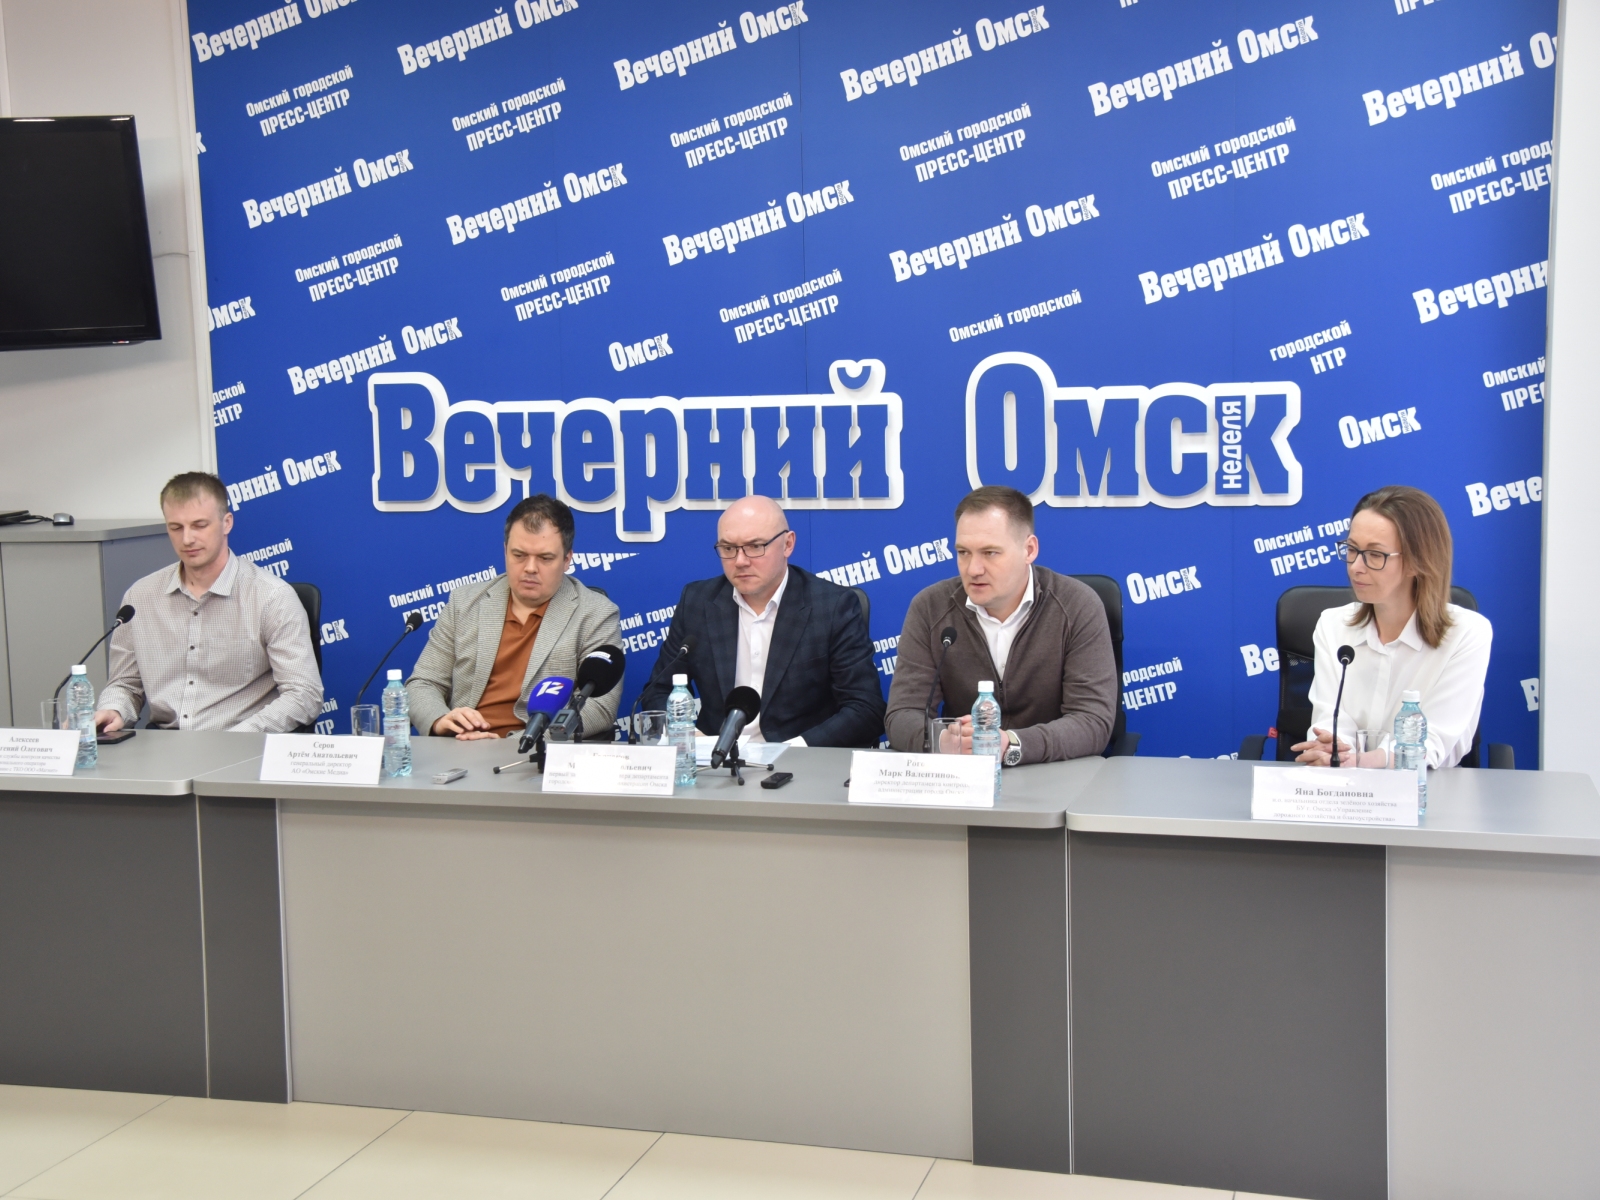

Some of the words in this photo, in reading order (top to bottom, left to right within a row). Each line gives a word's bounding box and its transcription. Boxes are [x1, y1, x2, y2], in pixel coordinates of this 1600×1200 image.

[192, 0, 302, 62] Вечерний
[397, 7, 512, 75] Вечерний
[515, 0, 578, 28] Омск
[614, 21, 737, 90] Вечерний
[740, 1, 808, 43] Омск
[840, 28, 972, 101] Вечерний
[976, 5, 1049, 51] Омск
[246, 90, 290, 116] Омский
[293, 65, 353, 99] городской
[1088, 39, 1233, 116] Вечерний
[1237, 16, 1318, 63] Омск
[1362, 43, 1524, 126] Вечерний
[260, 89, 349, 136] ПРЕСС-ЦЕНТР
[452, 103, 499, 131] Омский
[502, 78, 565, 112] городской
[466, 102, 561, 151] ПРЕСС-ЦЕНТР
[670, 118, 720, 147] Омский
[724, 92, 792, 128] городской
[685, 117, 787, 168] ПРЕСС-ЦЕНТР
[900, 131, 953, 161] Омский
[957, 103, 1031, 141] городской
[915, 129, 1025, 182] ПРЕСС-ЦЕНТР
[1151, 145, 1210, 177] Омский
[1214, 116, 1296, 156] городской
[243, 167, 352, 228] Вечерний
[353, 149, 413, 187] Омск
[1168, 144, 1289, 199] ПРЕСС-ЦЕНТР
[1431, 156, 1497, 190] Омский
[1502, 140, 1554, 169] город
[446, 181, 561, 245] Вечерний
[564, 163, 627, 202] Омск
[663, 200, 786, 266] Вечерний
[786, 180, 854, 223] Омск
[295, 256, 339, 282] Омский
[342, 234, 402, 266] городской
[889, 213, 1022, 282] Вечерний
[1025, 194, 1100, 237] Омск
[1138, 233, 1284, 304] Вечерний
[1288, 213, 1370, 257] Омск
[309, 257, 398, 302] ПРЕСС-ЦЕНТР
[501, 275, 548, 301] Омский
[551, 251, 614, 284] городской
[515, 275, 610, 321] ПРЕСС-ЦЕНТР
[720, 295, 770, 322] Омский
[773, 269, 842, 305] городской
[734, 295, 838, 343] ПРЕСС-ЦЕНТР
[949, 314, 1003, 342] Омский
[1007, 289, 1082, 324] городской
[1270, 320, 1352, 361] городской
[287, 335, 396, 395] Вечерний
[402, 317, 462, 354] Омск
[609, 333, 673, 371] Омск
[1310, 347, 1346, 374] НТР
[368, 359, 904, 542] Вечерний
[965, 351, 1302, 508] Омск
[1222, 401, 1242, 489] неделя
[1339, 407, 1421, 448] Омск
[283, 451, 341, 485] Омск
[883, 538, 953, 575] Омск
[1254, 525, 1314, 554] Омский
[389, 584, 434, 608] Омский
[1127, 566, 1201, 604] Омск
[619, 613, 643, 631] кий
[536, 681, 564, 697] 12
[287, 751, 310, 759] Артём
[313, 741, 335, 750] Серов
[879, 769, 903, 778] Марк
[905, 770, 960, 779] Валентинов
[1295, 787, 1314, 796] Яна
[1317, 788, 1374, 798] Богдановна
